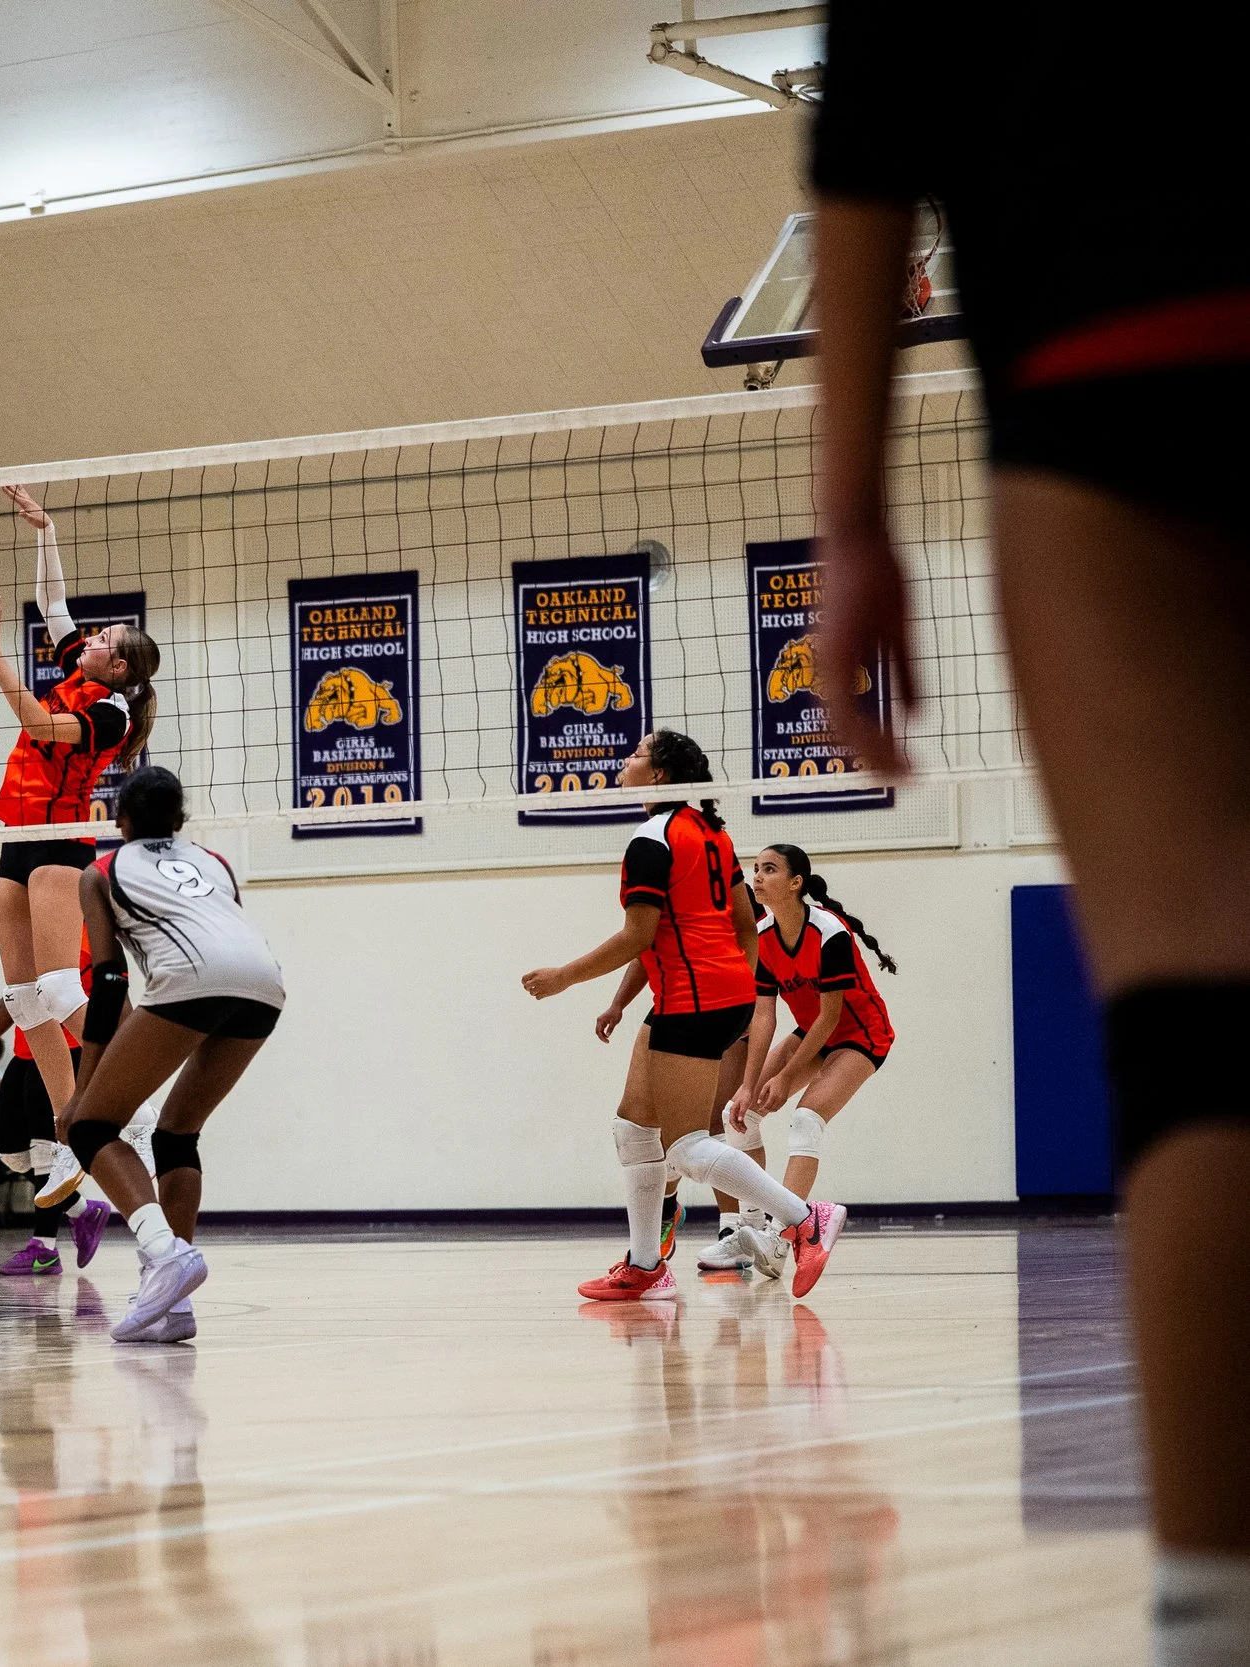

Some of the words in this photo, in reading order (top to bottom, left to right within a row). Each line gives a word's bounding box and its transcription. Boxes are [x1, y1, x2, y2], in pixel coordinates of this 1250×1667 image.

[770, 571, 824, 591] OAKL
[536, 588, 626, 608] OAKLAND
[760, 590, 825, 609] TECHN
[309, 605, 397, 625] OAKLAND
[526, 604, 636, 625] TECHNICAL
[761, 612, 805, 628] HIGH
[302, 621, 405, 642] TECHNICAL
[526, 629, 569, 645] HIGH
[572, 625, 636, 642] SCHOOL
[302, 646, 342, 661] HIGH
[345, 642, 404, 658] SCHOOL
[800, 708, 831, 721] GIR
[563, 722, 604, 736] GIRLS
[776, 718, 830, 735] BASKET
[335, 736, 375, 750] GIRLS
[539, 733, 627, 748] BASKETBALL
[791, 732, 835, 745] DIVISIO
[312, 747, 395, 763] BASKETBALL
[553, 748, 605, 760] DIVISION
[764, 746, 802, 760] STATE
[804, 744, 860, 758] CHAMPI
[326, 762, 376, 773] DIVISION
[528, 760, 564, 773] STATE
[566, 759, 625, 772] CHAMPIO
[301, 774, 338, 787] STATE
[339, 770, 409, 786] CHAMPIONS
[534, 772, 623, 795] 202
[306, 784, 403, 808] 2019
[156, 859, 215, 898] 9
[704, 840, 727, 912] 8
